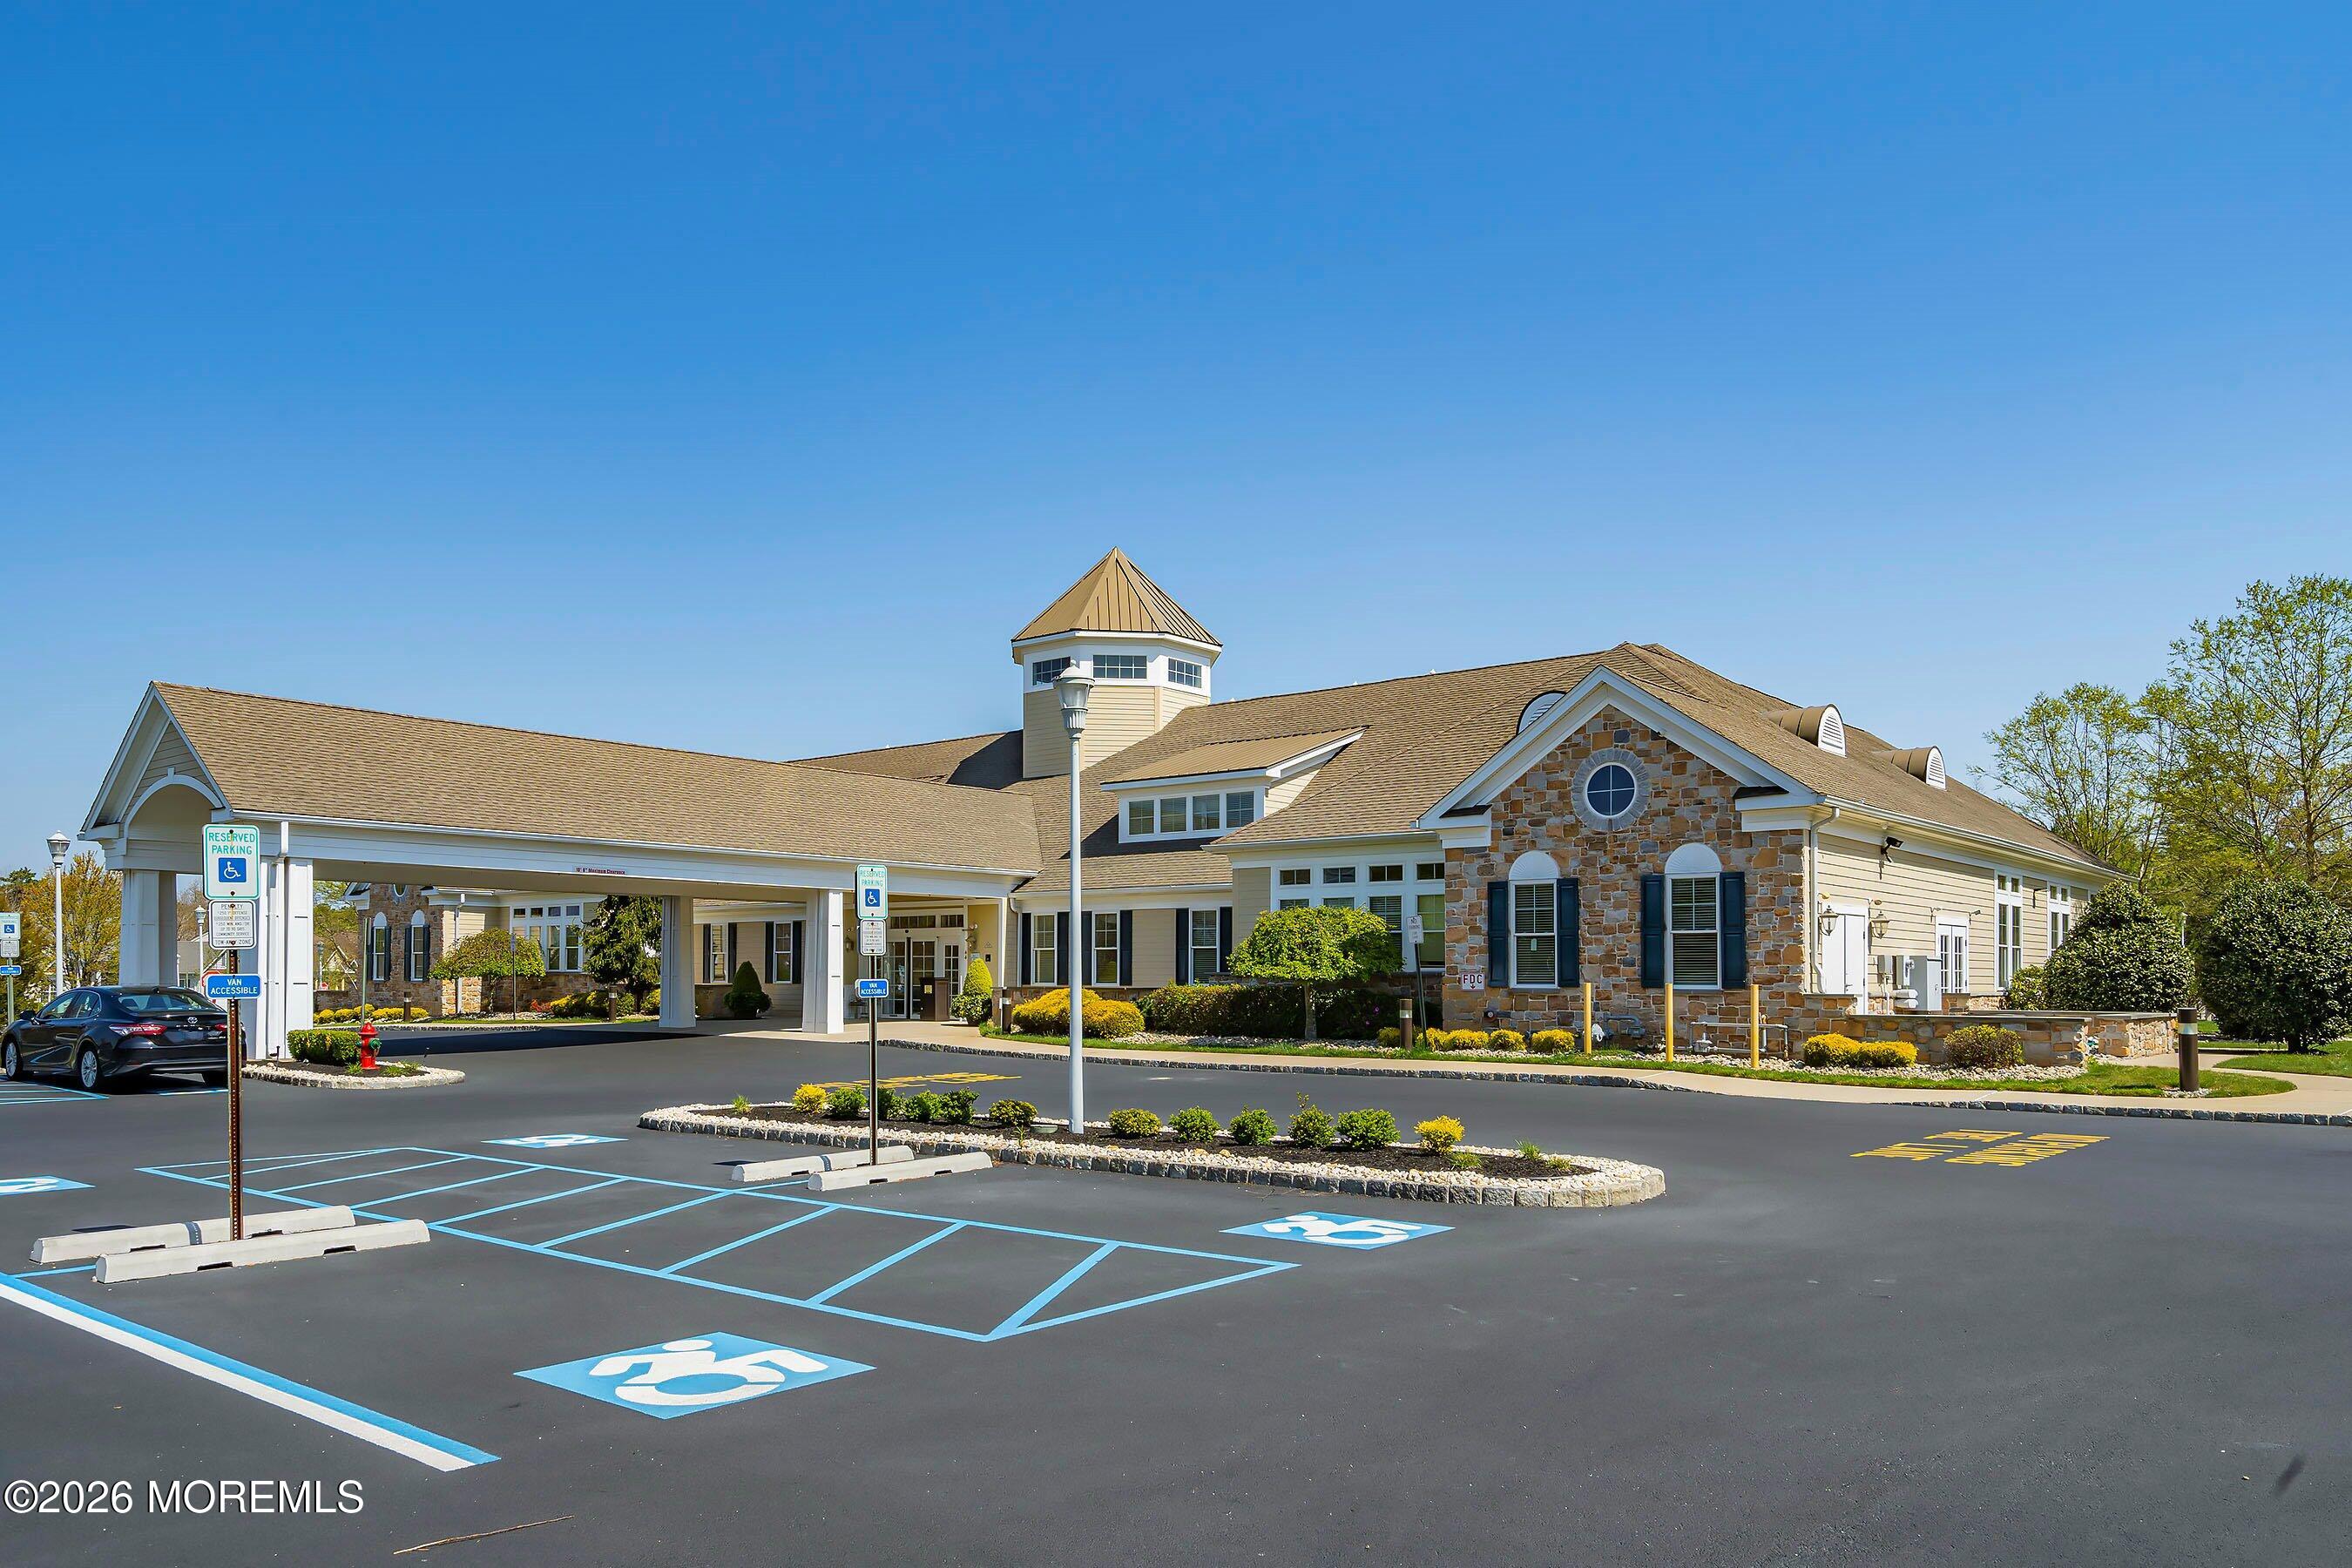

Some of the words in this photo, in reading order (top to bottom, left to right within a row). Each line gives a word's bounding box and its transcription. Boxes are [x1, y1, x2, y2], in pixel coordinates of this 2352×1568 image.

[208, 832, 255, 842] RESERVED
[212, 845, 253, 855] PARKING
[1463, 975, 1483, 984] FDC
[210, 986, 258, 995] ACCESSIBLE
